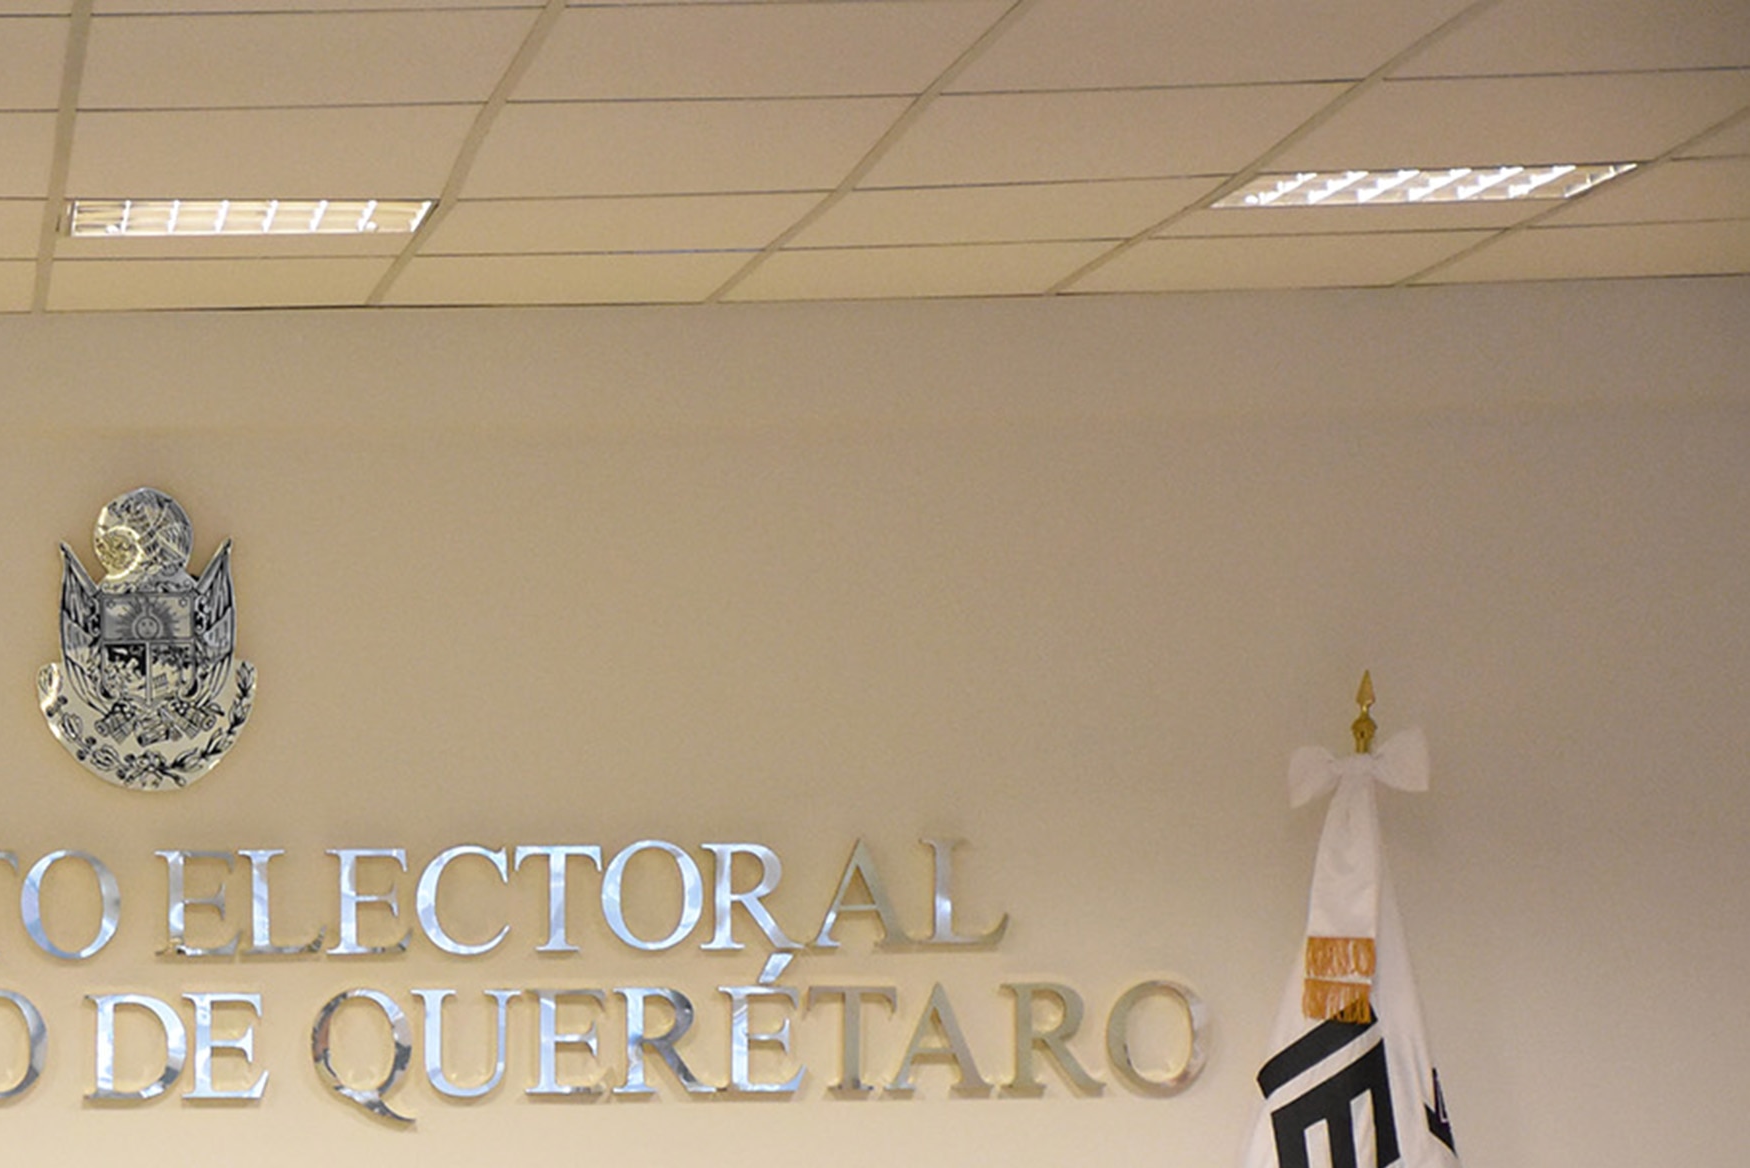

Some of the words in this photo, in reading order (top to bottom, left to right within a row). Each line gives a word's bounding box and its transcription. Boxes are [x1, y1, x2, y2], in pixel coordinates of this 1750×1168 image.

[154, 836, 1012, 960] ELECTORAL
[83, 987, 270, 1103] DE
[311, 953, 1208, 1124] QUERÉTARO
